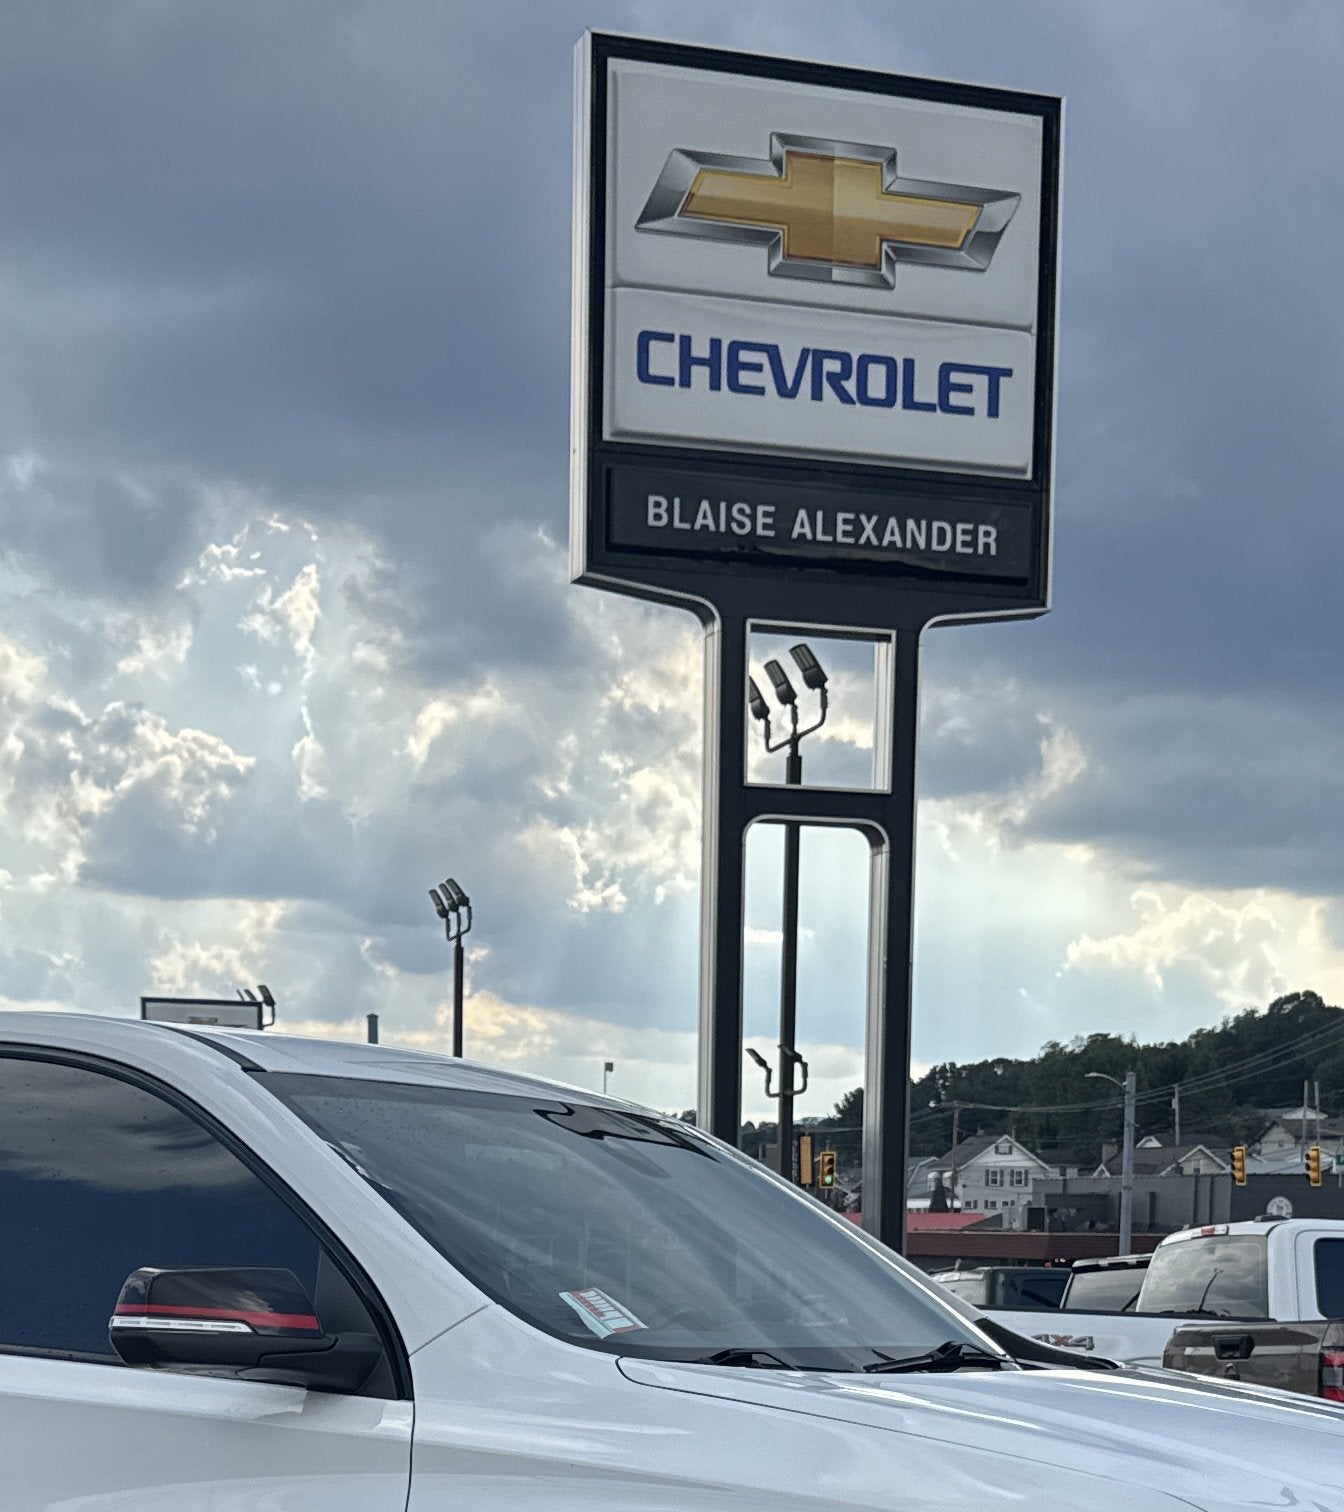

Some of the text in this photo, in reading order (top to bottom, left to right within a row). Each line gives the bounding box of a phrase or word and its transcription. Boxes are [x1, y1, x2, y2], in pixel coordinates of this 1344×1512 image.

[636, 329, 1014, 419] CHEVROLET
[646, 494, 998, 556] BLAISE ALEXANDER
